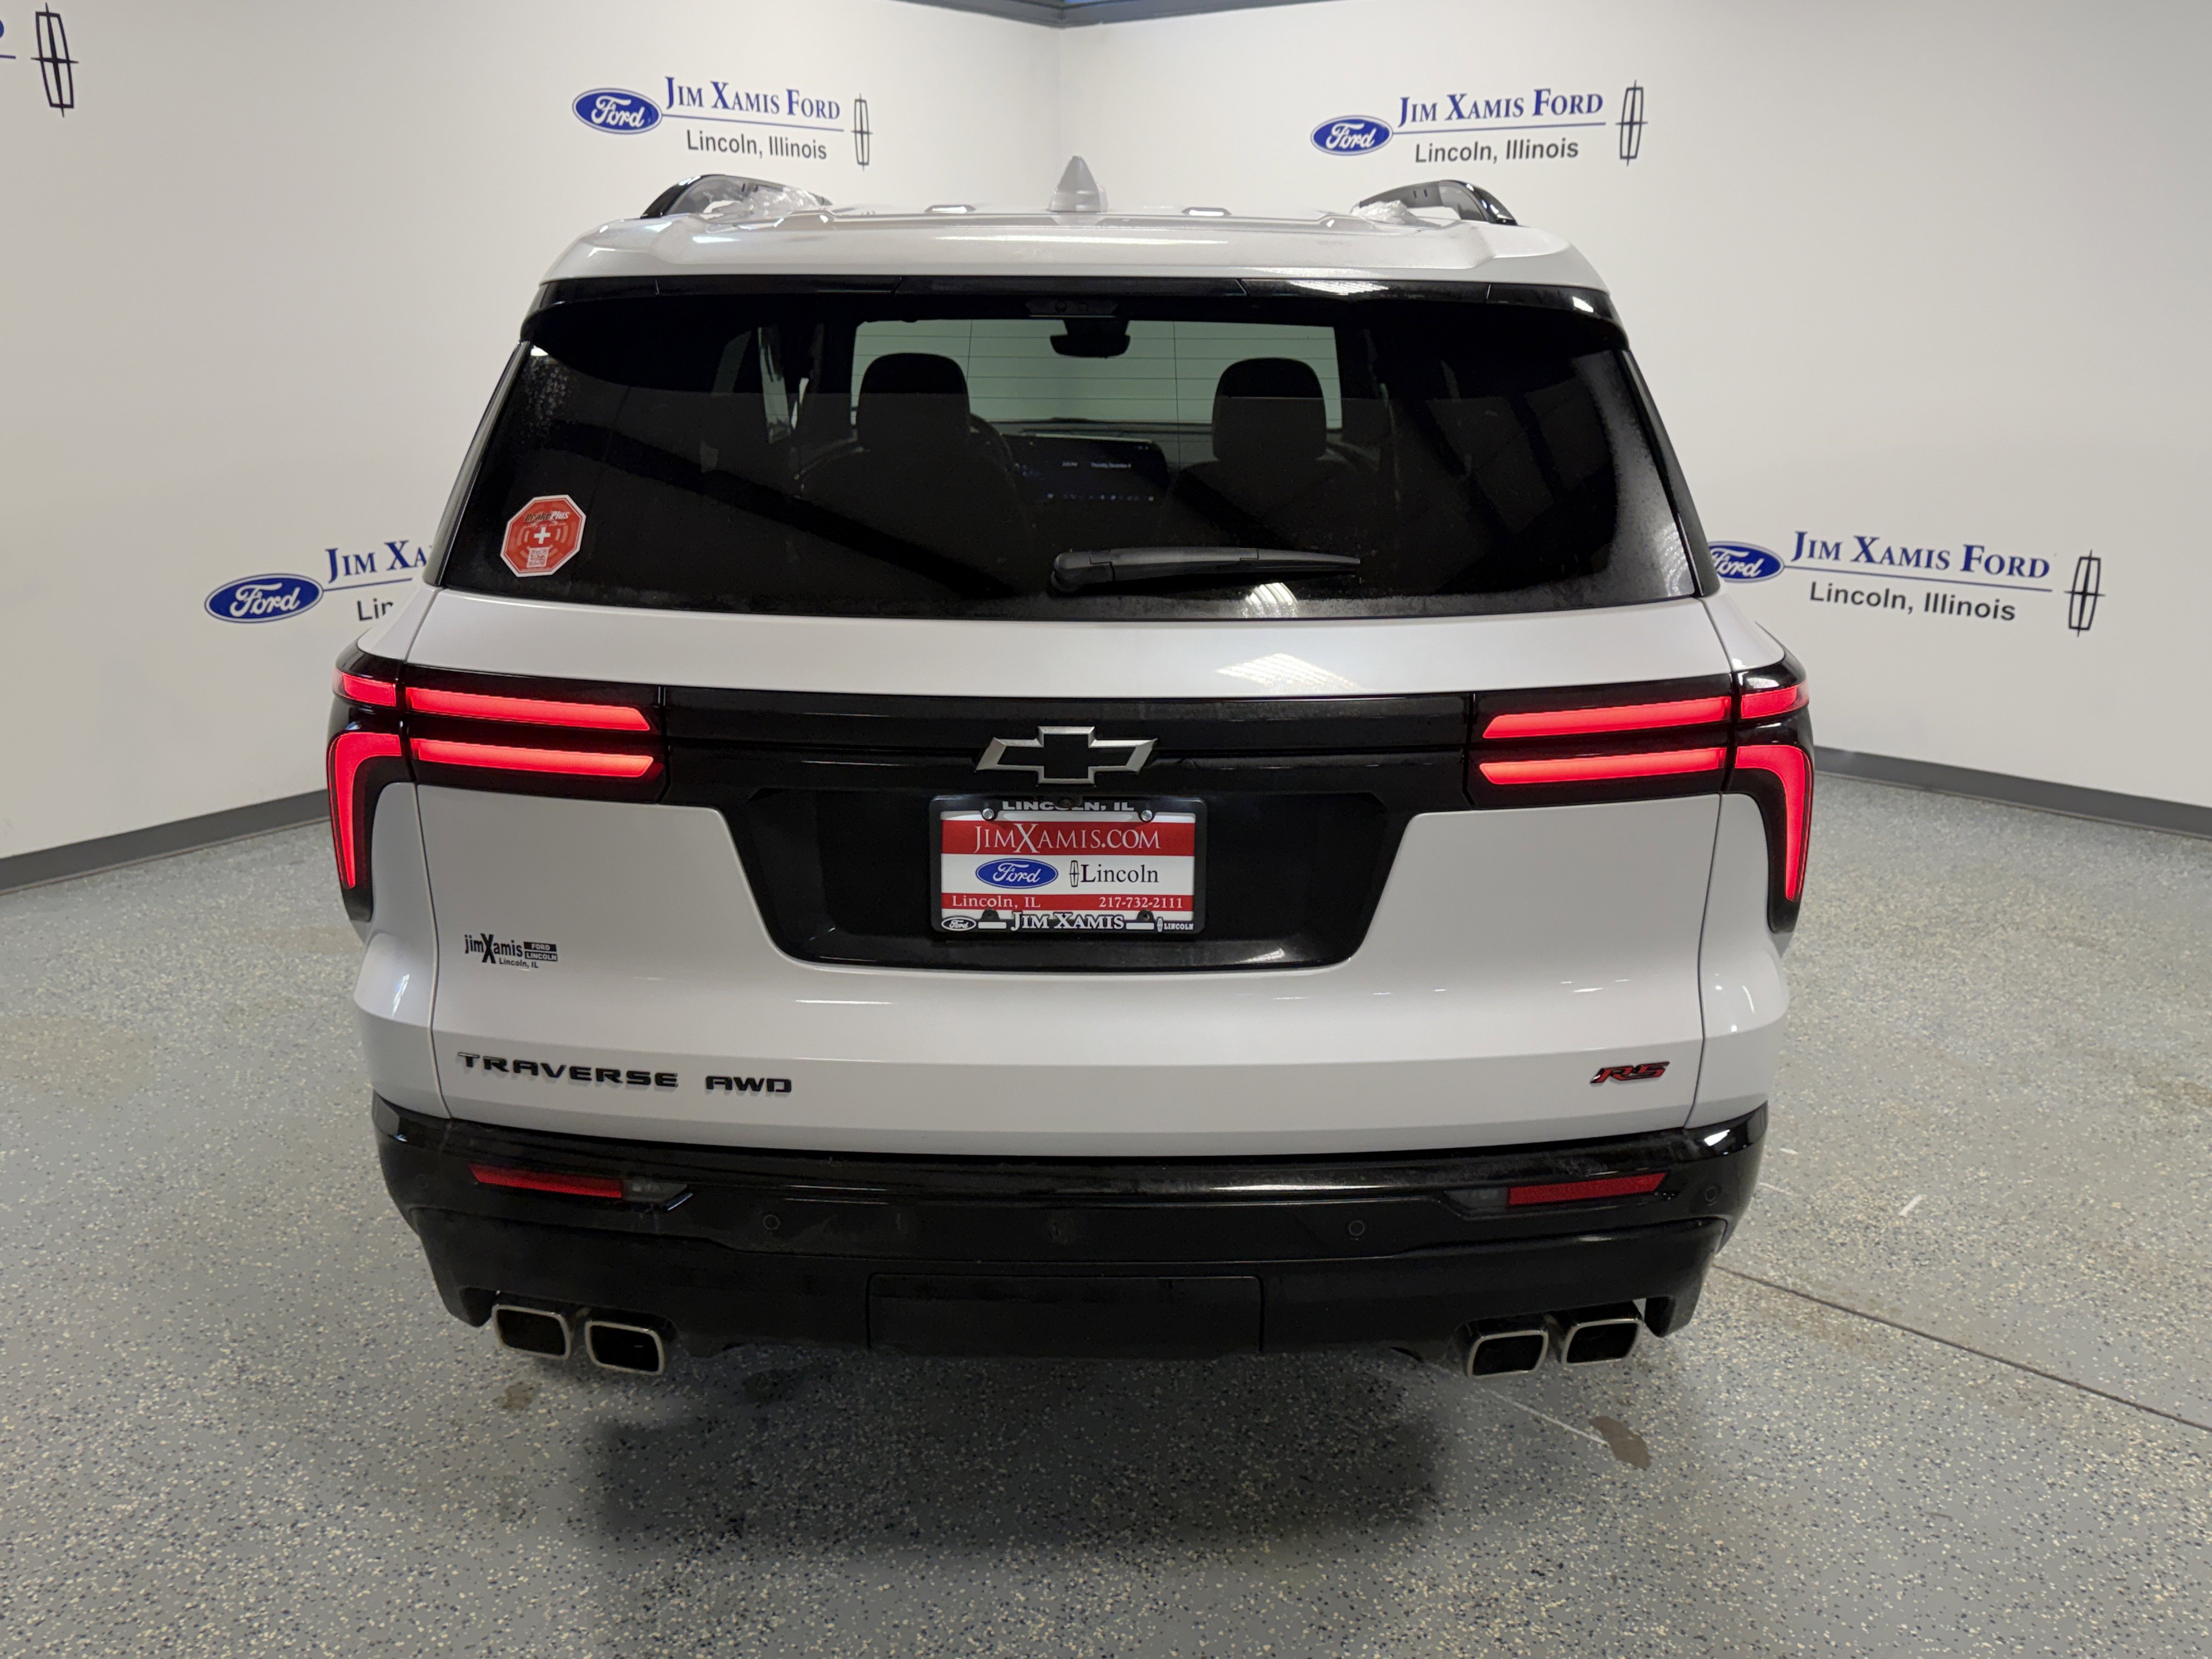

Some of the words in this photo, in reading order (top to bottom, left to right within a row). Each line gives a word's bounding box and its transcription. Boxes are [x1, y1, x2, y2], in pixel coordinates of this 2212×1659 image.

[591, 95, 645, 128] Ford
[664, 76, 704, 110] JIM
[710, 81, 780, 115] XAMIS
[786, 88, 841, 120] FORD
[1398, 96, 1438, 128] JIM
[1444, 93, 1524, 120] XAMIS
[1532, 88, 1604, 117] FORD
[686, 129, 764, 159] Lincoln,
[769, 135, 827, 160] Illinois
[1325, 122, 1376, 150] Ford
[1414, 140, 1498, 165] Lincoln,
[1505, 138, 1579, 160] Illinois
[325, 548, 377, 584] JIM
[1709, 548, 1765, 577] Ford
[1791, 530, 1844, 562] JIM
[1851, 534, 1951, 570] XAMIS
[1960, 543, 2050, 580] FORD
[229, 582, 301, 618] Ford
[1809, 581, 1914, 616] Lincoln,
[1923, 590, 2016, 622] Illinois
[1114, 801, 1135, 811] IL
[974, 823, 1162, 854] JIMXAMIS.COM
[992, 863, 1041, 884] Ford
[1080, 864, 1159, 884] Lincoln
[952, 895, 1018, 909] Lincoln,
[1024, 896, 1041, 908] IL
[1099, 896, 1183, 909] 217-732-2111
[949, 919, 969, 930] Ford
[1011, 911, 1050, 932] JIM
[1053, 912, 1125, 930] XAMIS
[499, 957, 529, 969] Lincoln,
[526, 952, 557, 961] LINCOLN
[457, 1052, 679, 1088] TRAVERSE
[705, 1075, 792, 1094] AWD
[1590, 1060, 1671, 1084] RS
